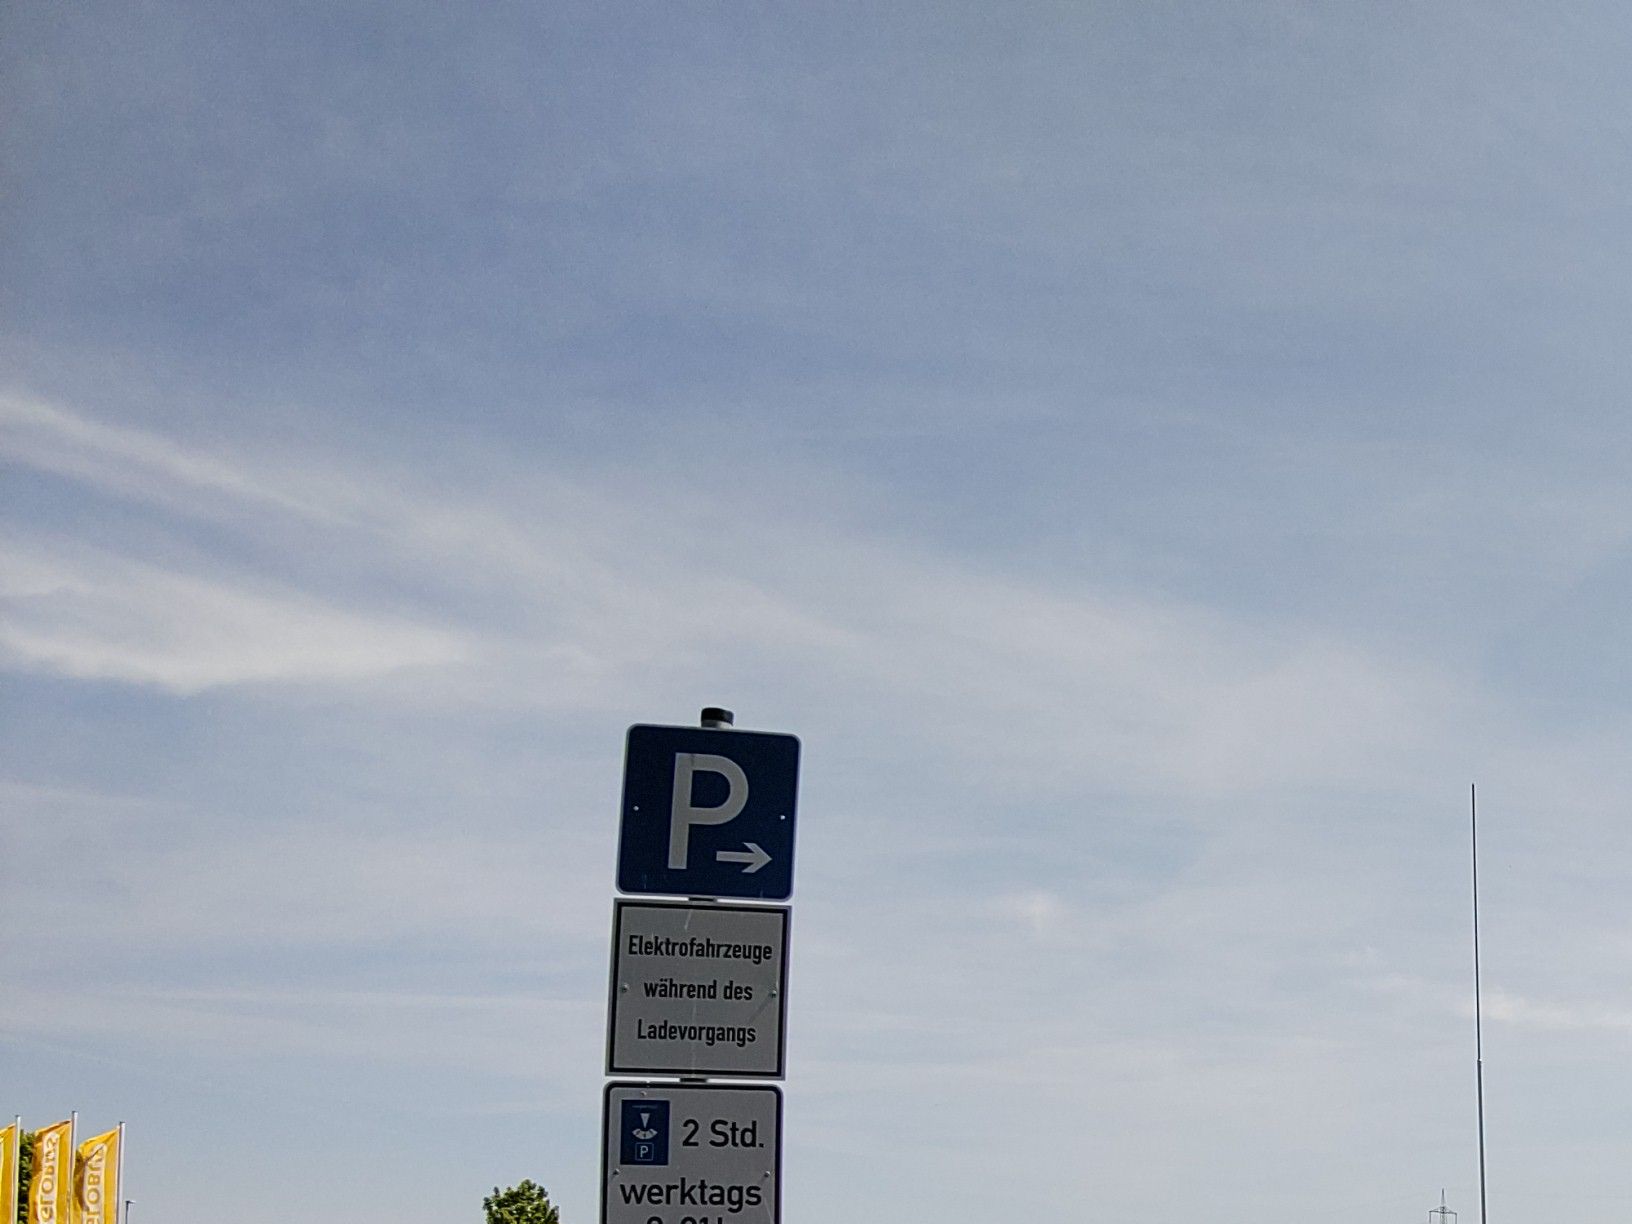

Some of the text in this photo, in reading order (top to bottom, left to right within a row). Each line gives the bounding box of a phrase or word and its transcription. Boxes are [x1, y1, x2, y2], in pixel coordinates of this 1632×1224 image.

[667, 752, 749, 870] P
[628, 934, 773, 965] Elektrofahrzeuge
[643, 977, 753, 1000] während des
[637, 1018, 757, 1048] Ladevorgangs
[682, 1118, 765, 1148] 2 Std.
[620, 1176, 763, 1213] werktags
